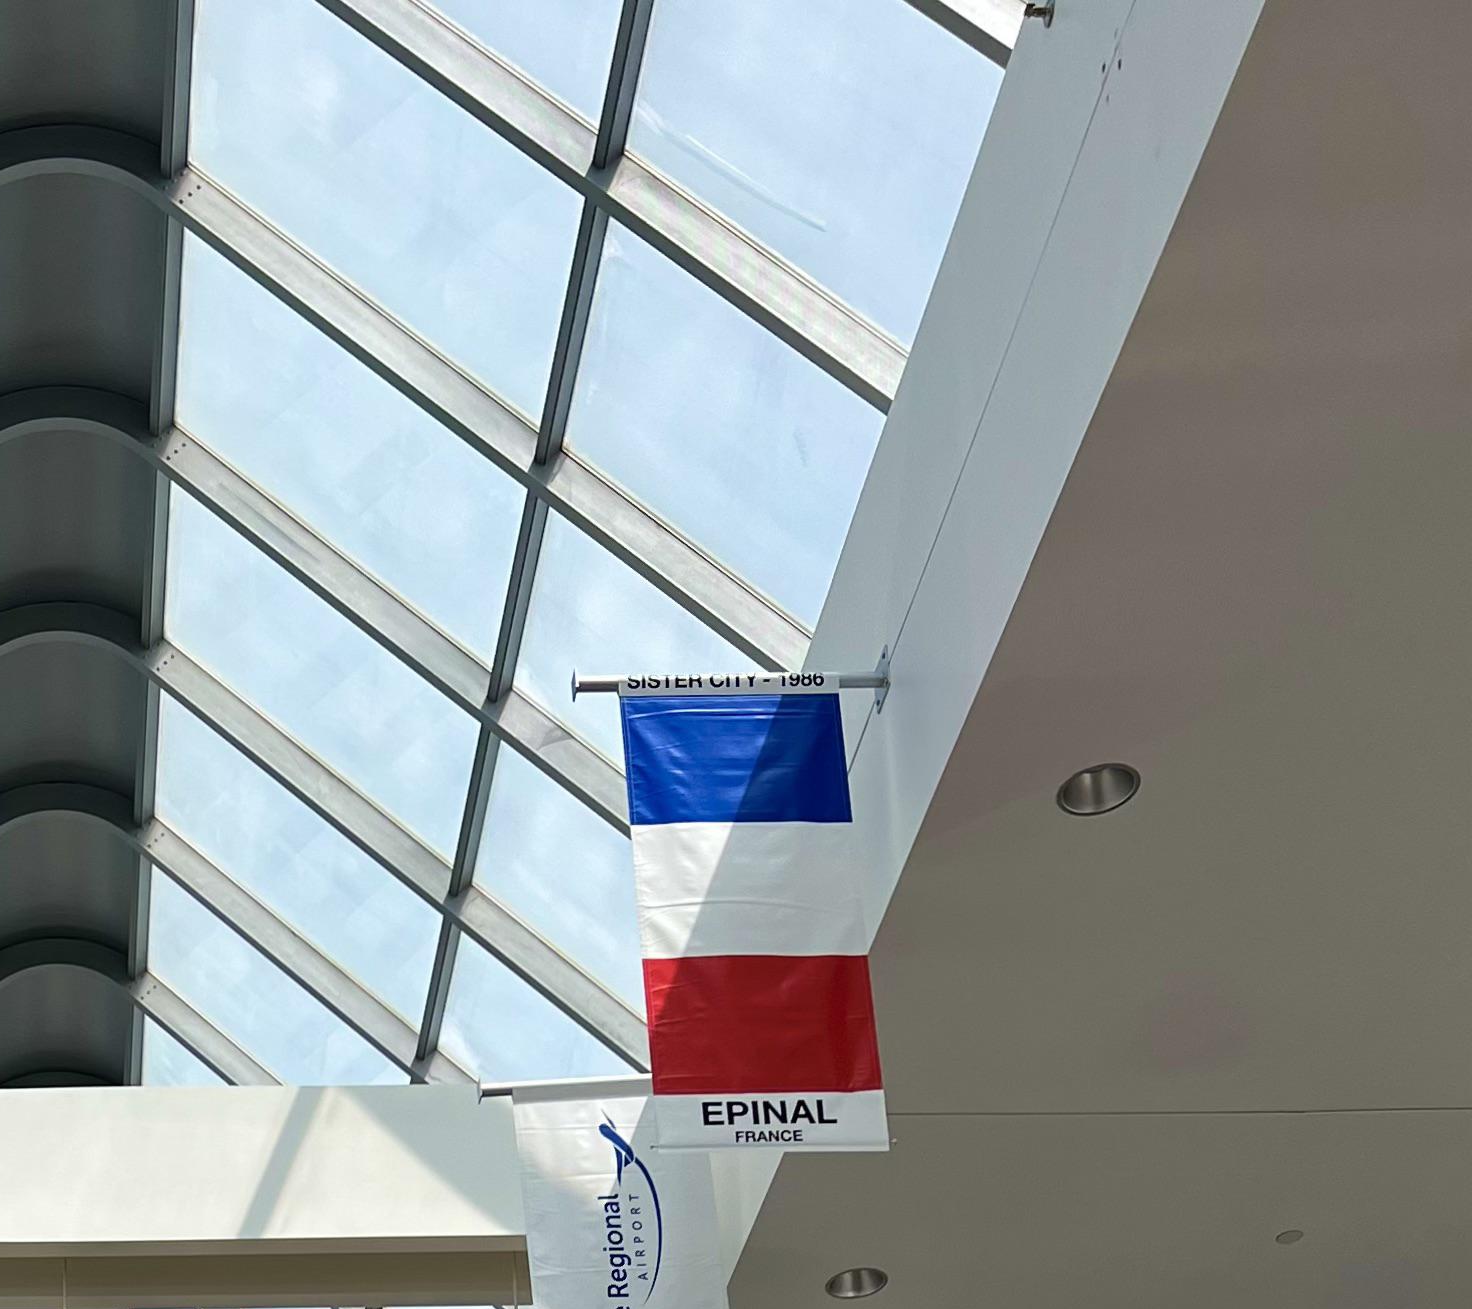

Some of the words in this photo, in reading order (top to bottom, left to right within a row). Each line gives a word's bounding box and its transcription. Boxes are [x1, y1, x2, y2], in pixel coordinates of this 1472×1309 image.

[627, 674, 703, 689] SISTER
[710, 674, 756, 688] CITY
[780, 672, 825, 687] 1986
[701, 1099, 838, 1126] EPINAL
[735, 1130, 804, 1143] FRANCE
[597, 1192, 632, 1299] Regional
[628, 1193, 649, 1281] AIRPORT
